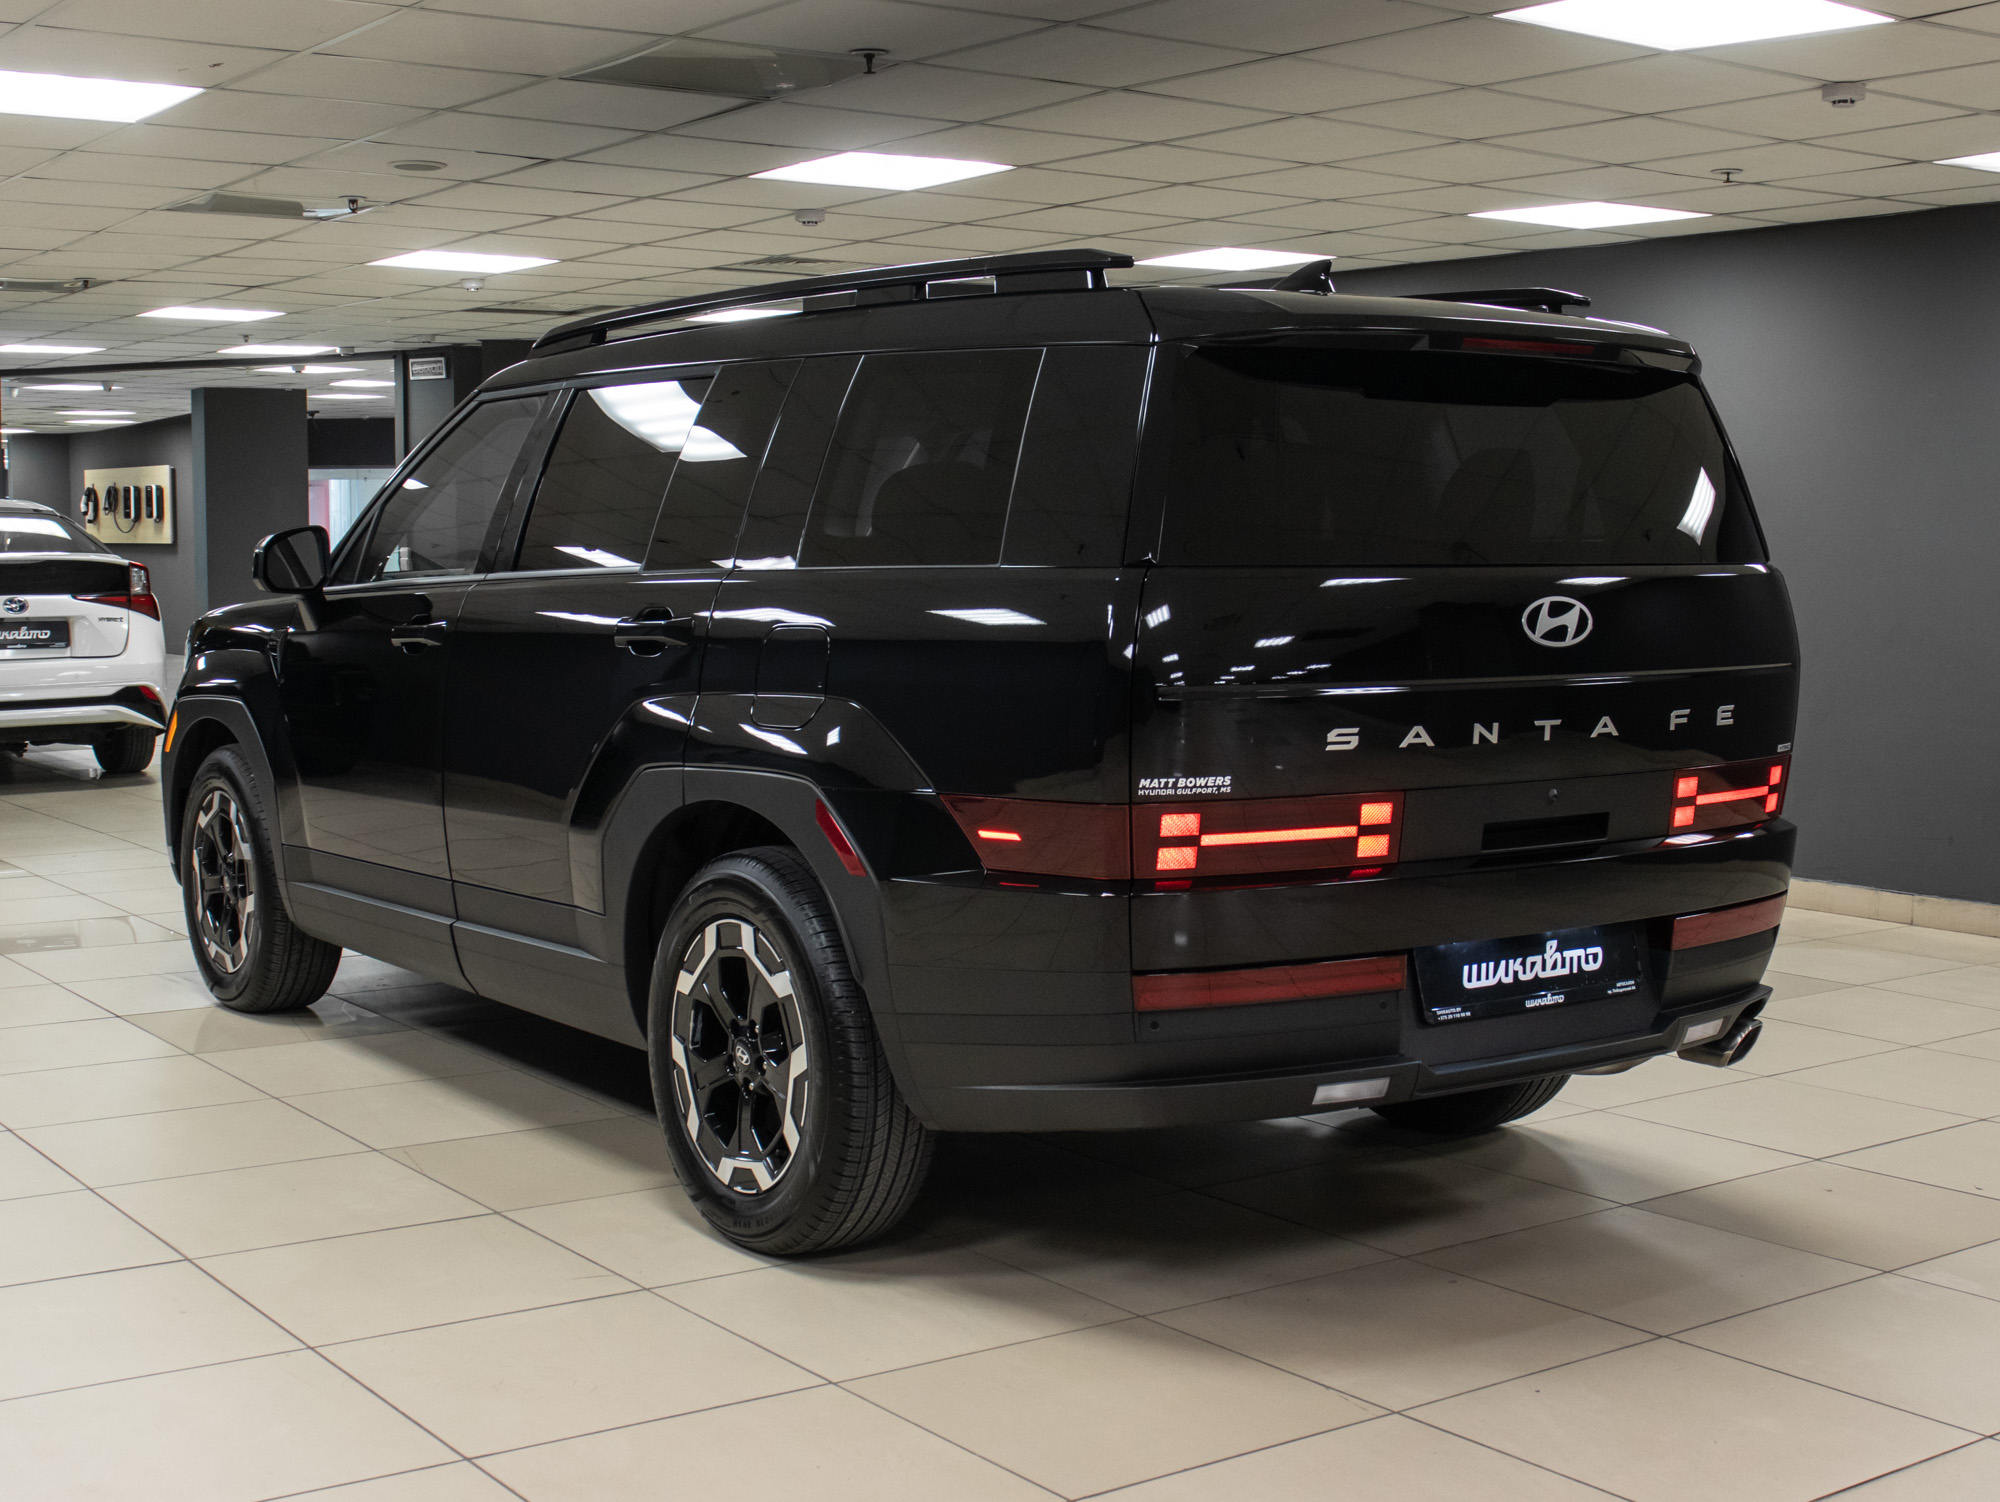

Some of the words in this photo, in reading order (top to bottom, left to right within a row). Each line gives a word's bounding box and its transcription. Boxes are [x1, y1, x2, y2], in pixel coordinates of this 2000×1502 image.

[1325, 715, 1619, 752] SANTA
[1669, 704, 1735, 731] FE
[1139, 778, 1176, 788] MATT
[1177, 776, 1232, 788] BOWERS
[1138, 788, 1175, 796] HYUNDAI
[1176, 787, 1218, 795] GULFPORT,
